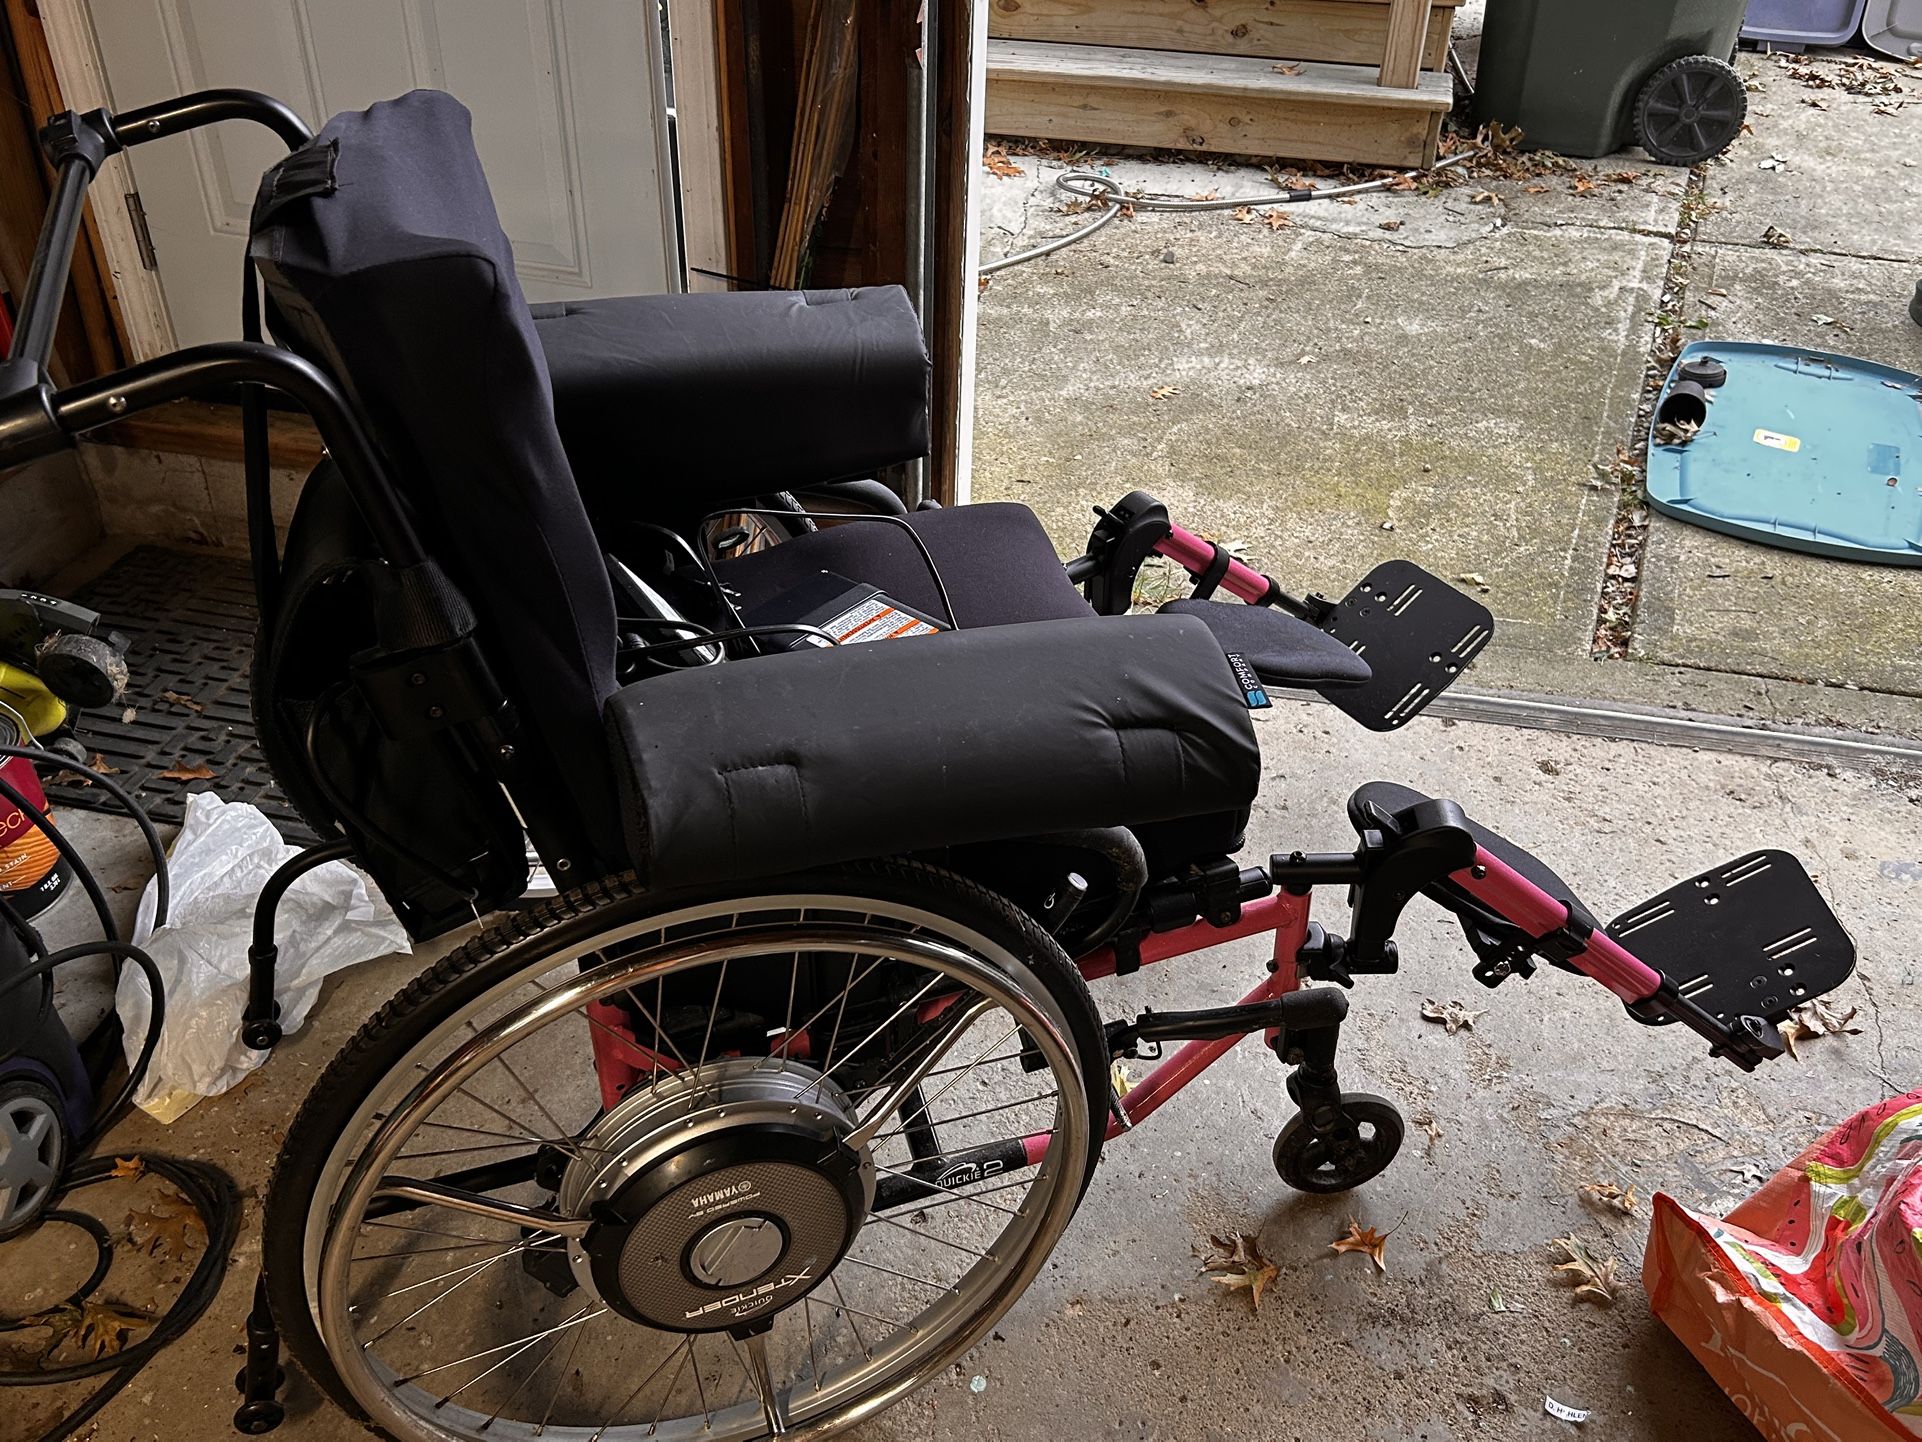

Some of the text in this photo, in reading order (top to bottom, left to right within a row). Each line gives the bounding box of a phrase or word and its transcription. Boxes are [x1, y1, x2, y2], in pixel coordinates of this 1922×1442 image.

[1228, 653, 1253, 690] COMFORT
[983, 1160, 1004, 1177] 2
[688, 1191, 761, 1219] POWERED BY
[691, 1185, 739, 1208] YAMAHA
[684, 1266, 812, 1318] XTENDER
[730, 1295, 773, 1314] QUICKIE
